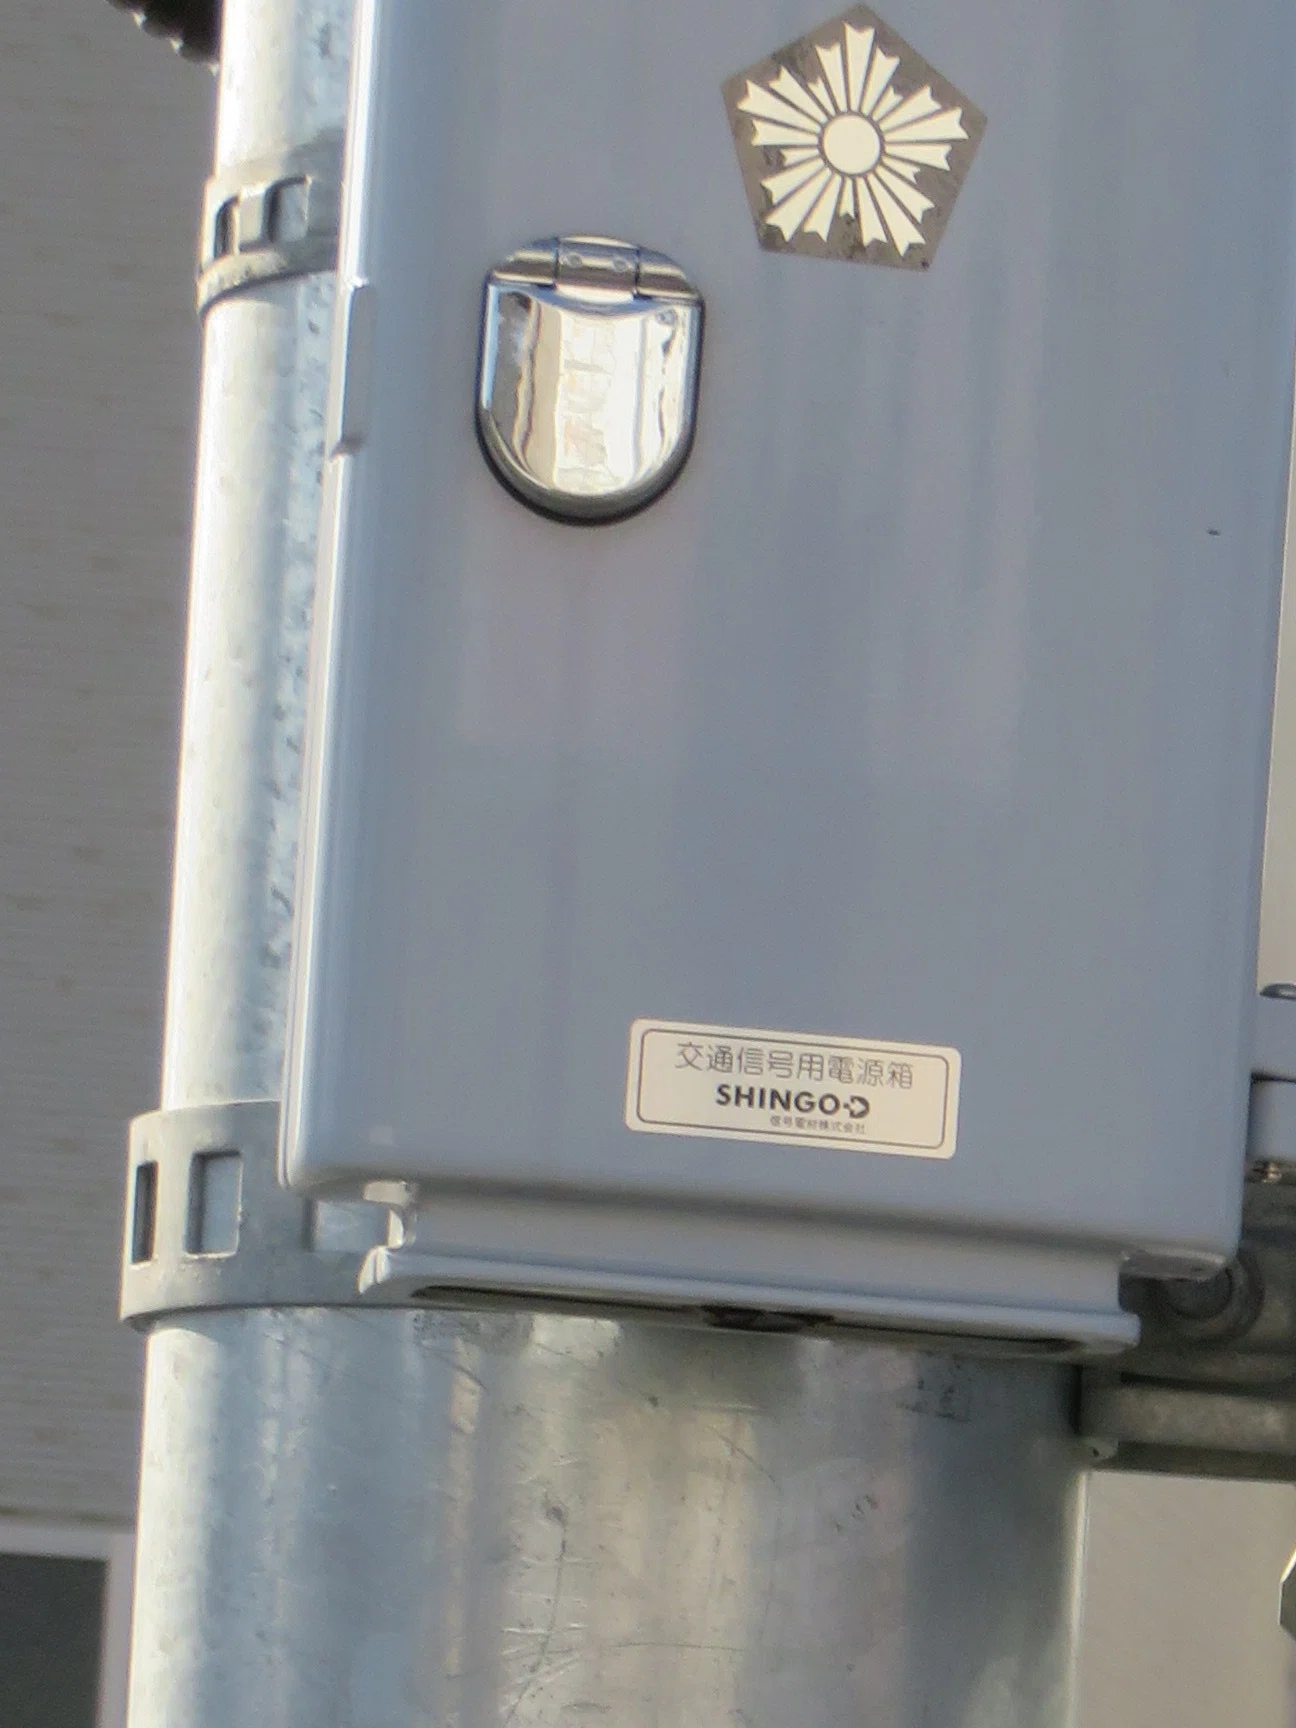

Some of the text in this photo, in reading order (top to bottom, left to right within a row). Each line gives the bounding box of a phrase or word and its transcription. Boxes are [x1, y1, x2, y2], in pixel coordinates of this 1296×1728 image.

[674, 1041, 914, 1090] 交通信号用電源箱
